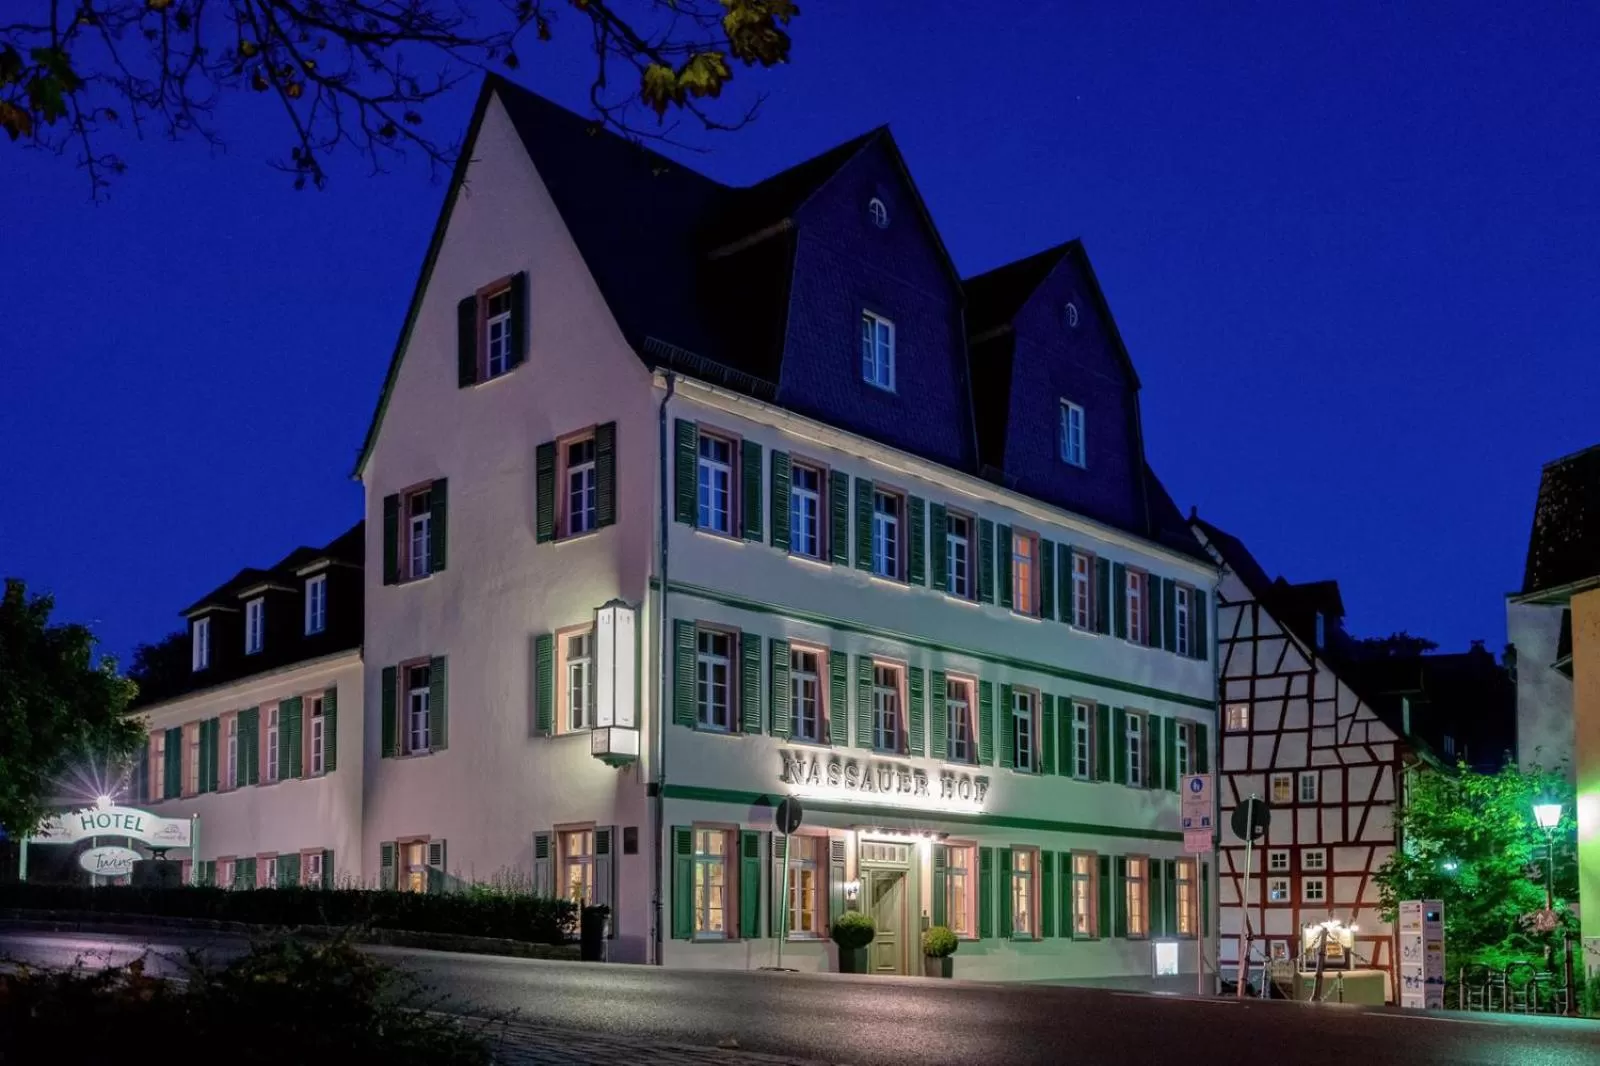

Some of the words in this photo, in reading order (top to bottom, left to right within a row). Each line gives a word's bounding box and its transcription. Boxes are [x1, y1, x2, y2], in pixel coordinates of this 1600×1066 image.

[785, 760, 930, 796] NASSAUER
[941, 777, 989, 802] HOF
[81, 813, 144, 833] HOTEL
